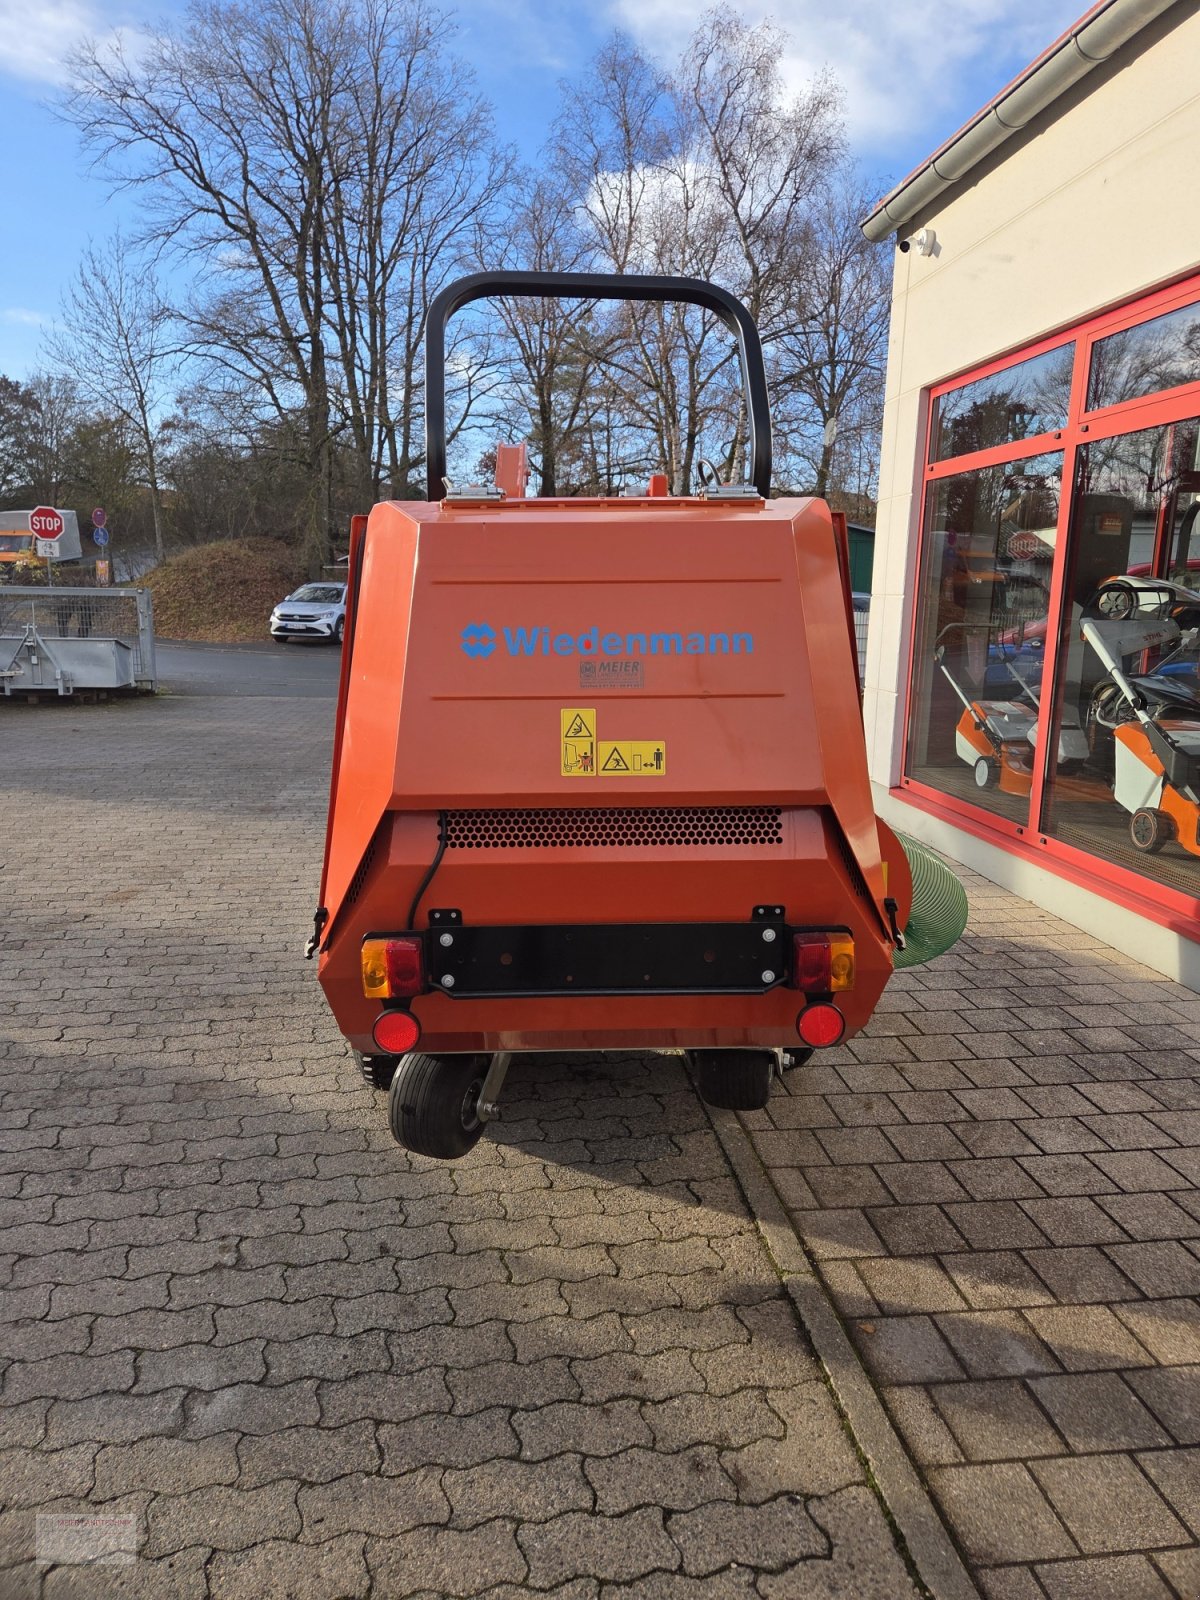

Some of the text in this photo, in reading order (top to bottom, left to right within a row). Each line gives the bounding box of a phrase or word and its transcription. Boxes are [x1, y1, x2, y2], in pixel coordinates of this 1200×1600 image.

[32, 516, 61, 530] STOP
[503, 626, 754, 656] Wiedenmann
[1143, 631, 1163, 642] STIHL
[598, 661, 640, 673] MEIER
